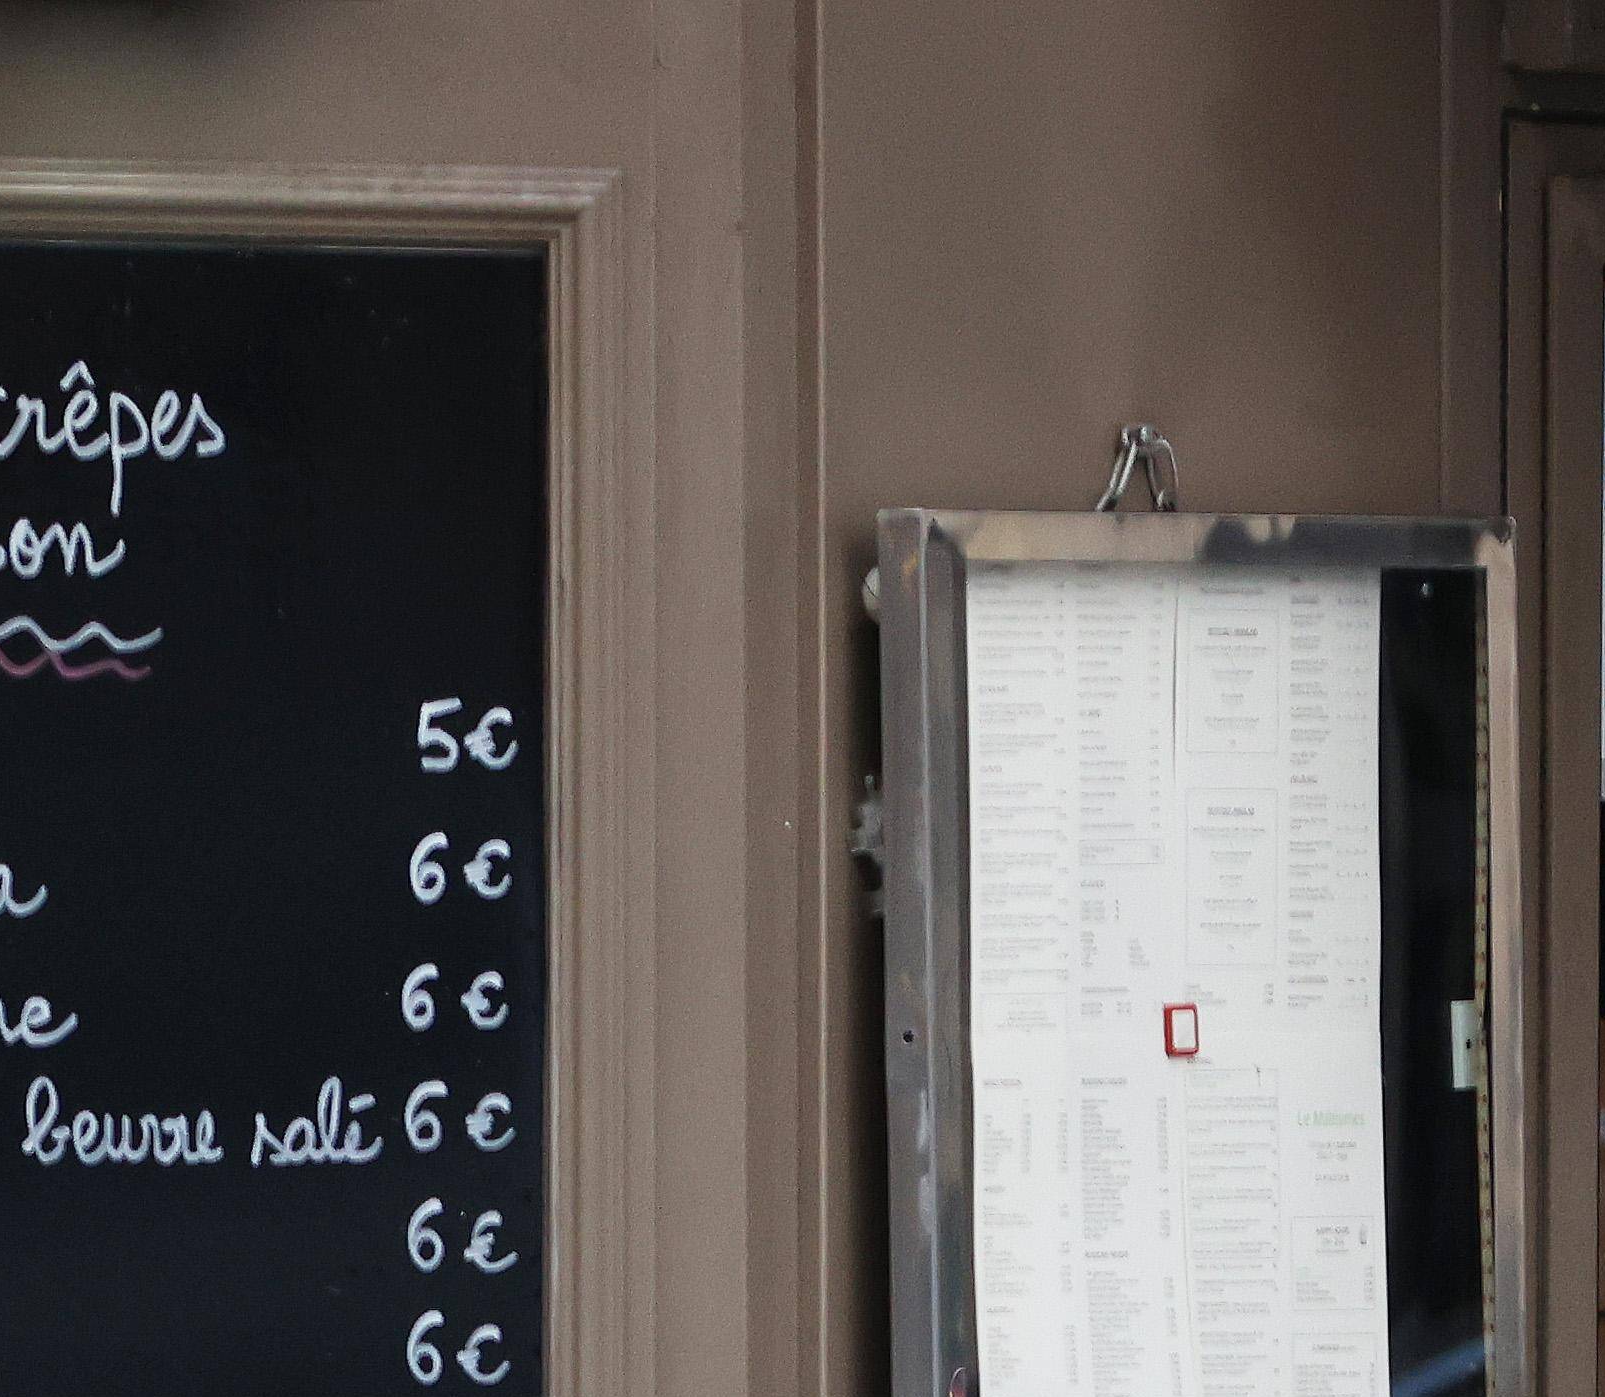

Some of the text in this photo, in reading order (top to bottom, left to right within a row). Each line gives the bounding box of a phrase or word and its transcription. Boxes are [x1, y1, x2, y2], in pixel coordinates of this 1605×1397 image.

[417, 698, 517, 772] 5€
[22, 1076, 223, 1165] beurre
[251, 1076, 382, 1166] salé
